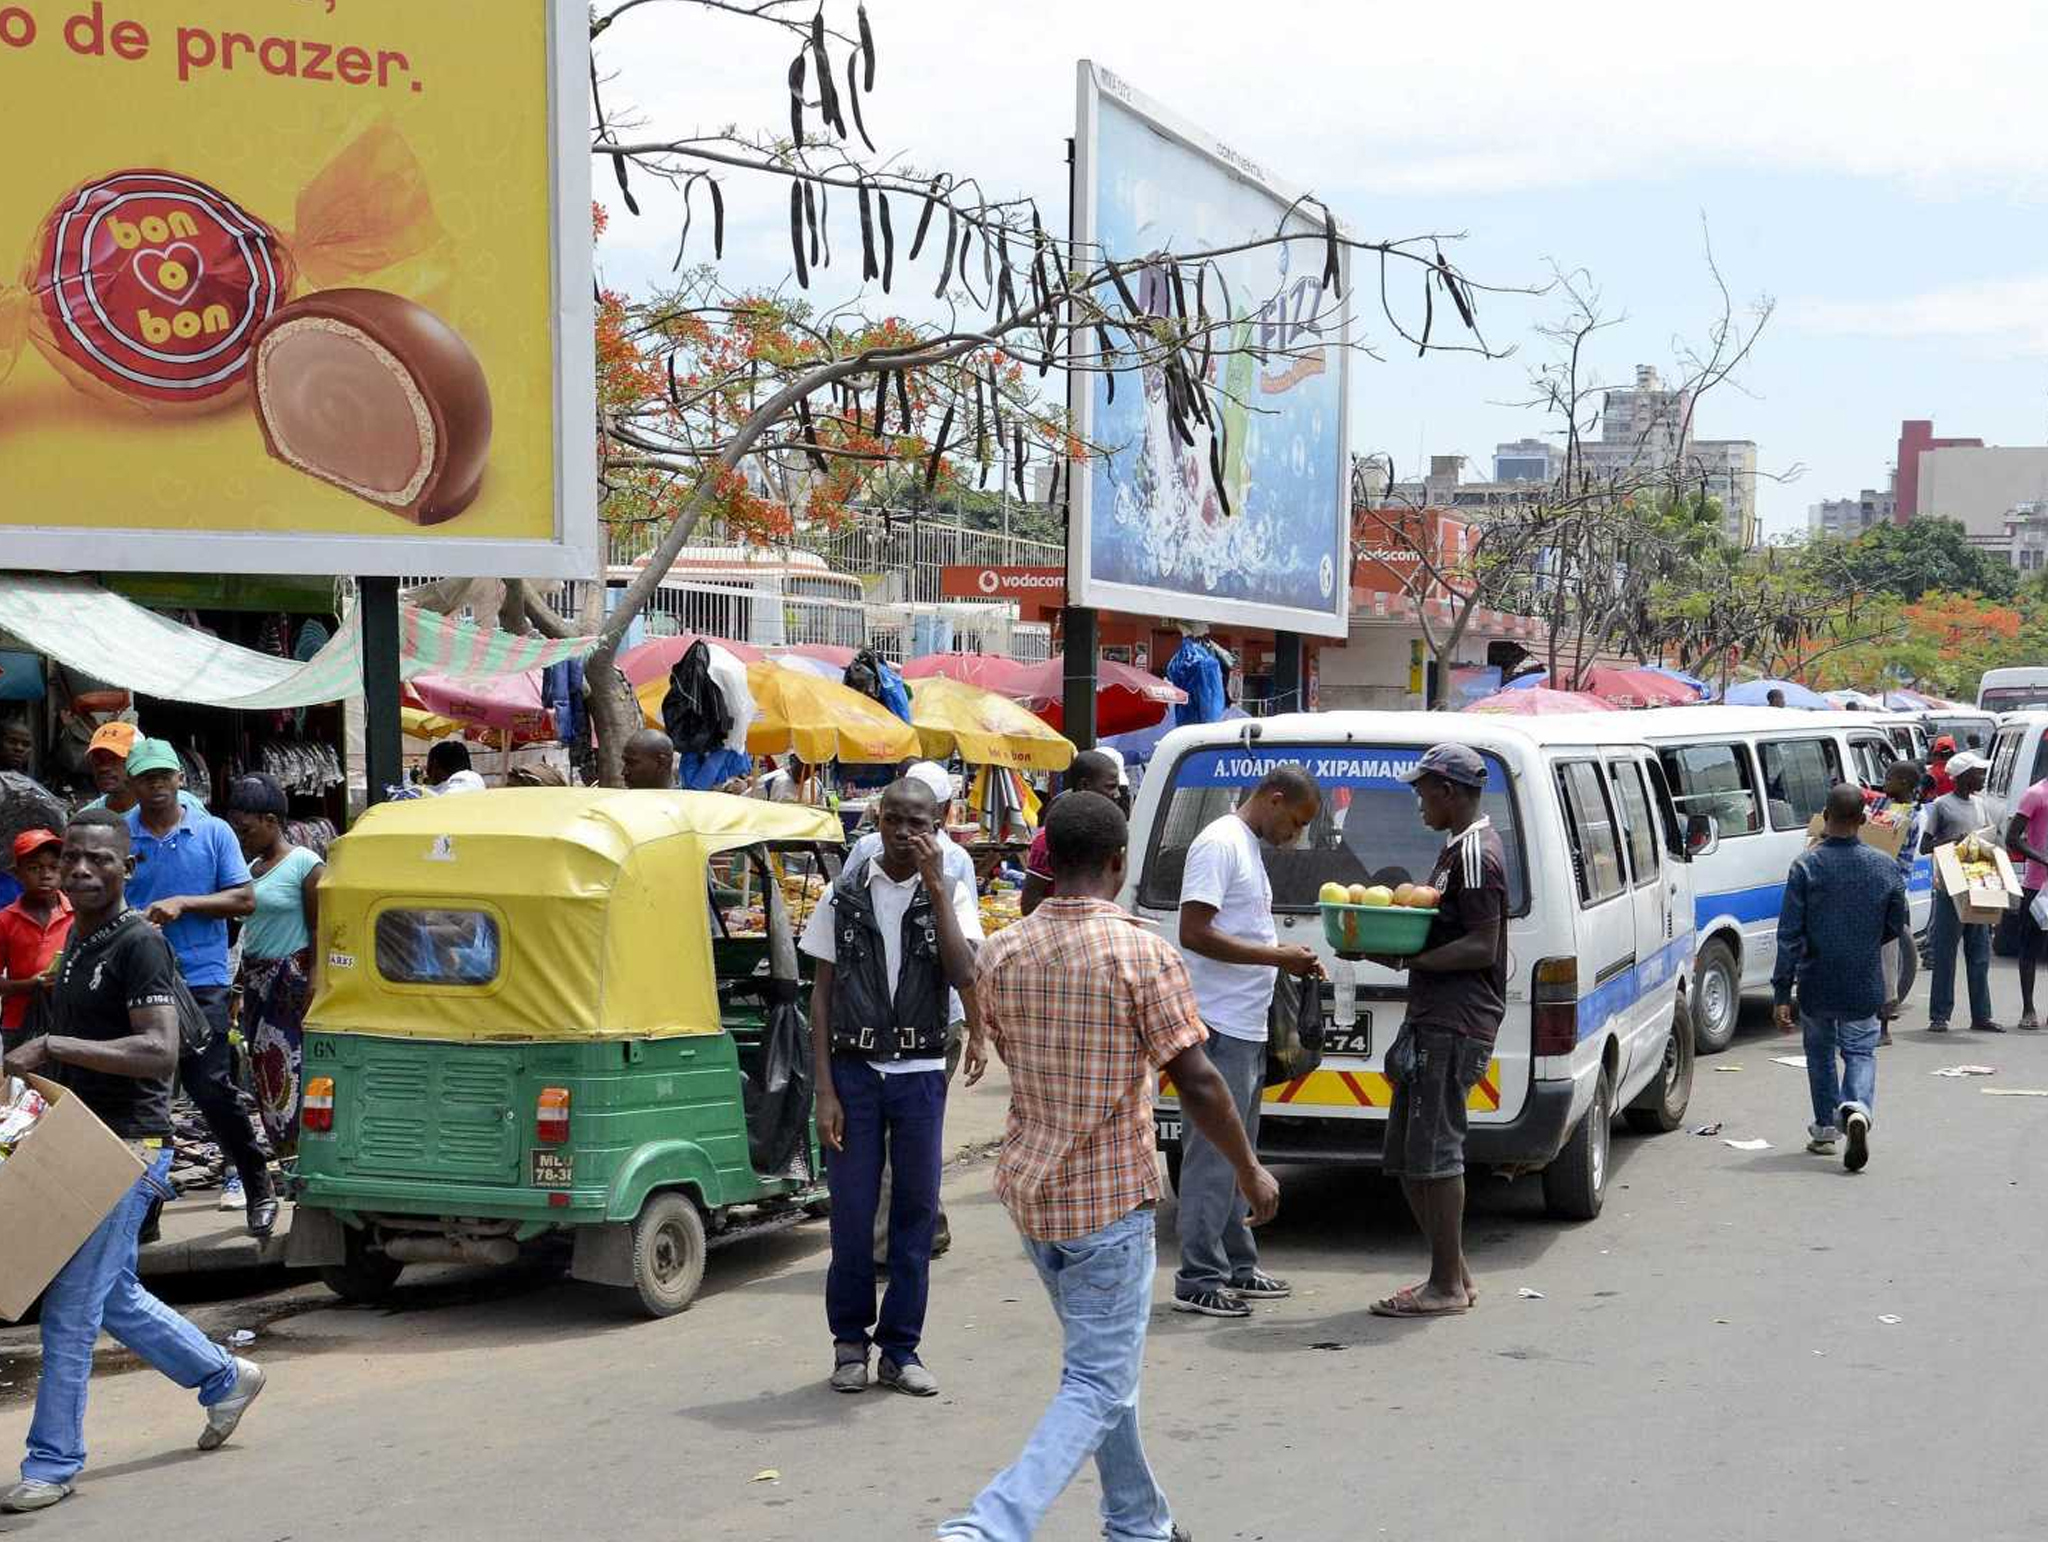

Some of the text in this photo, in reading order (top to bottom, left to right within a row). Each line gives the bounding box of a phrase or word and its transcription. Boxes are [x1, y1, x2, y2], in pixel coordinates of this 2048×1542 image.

[63, 1, 149, 61] de
[176, 26, 423, 93] prazer.
[105, 210, 199, 251] bon
[157, 260, 189, 291] o
[137, 304, 230, 345] bon
[313, 1040, 337, 1058] GN
[1324, 1035, 1367, 1051] -74
